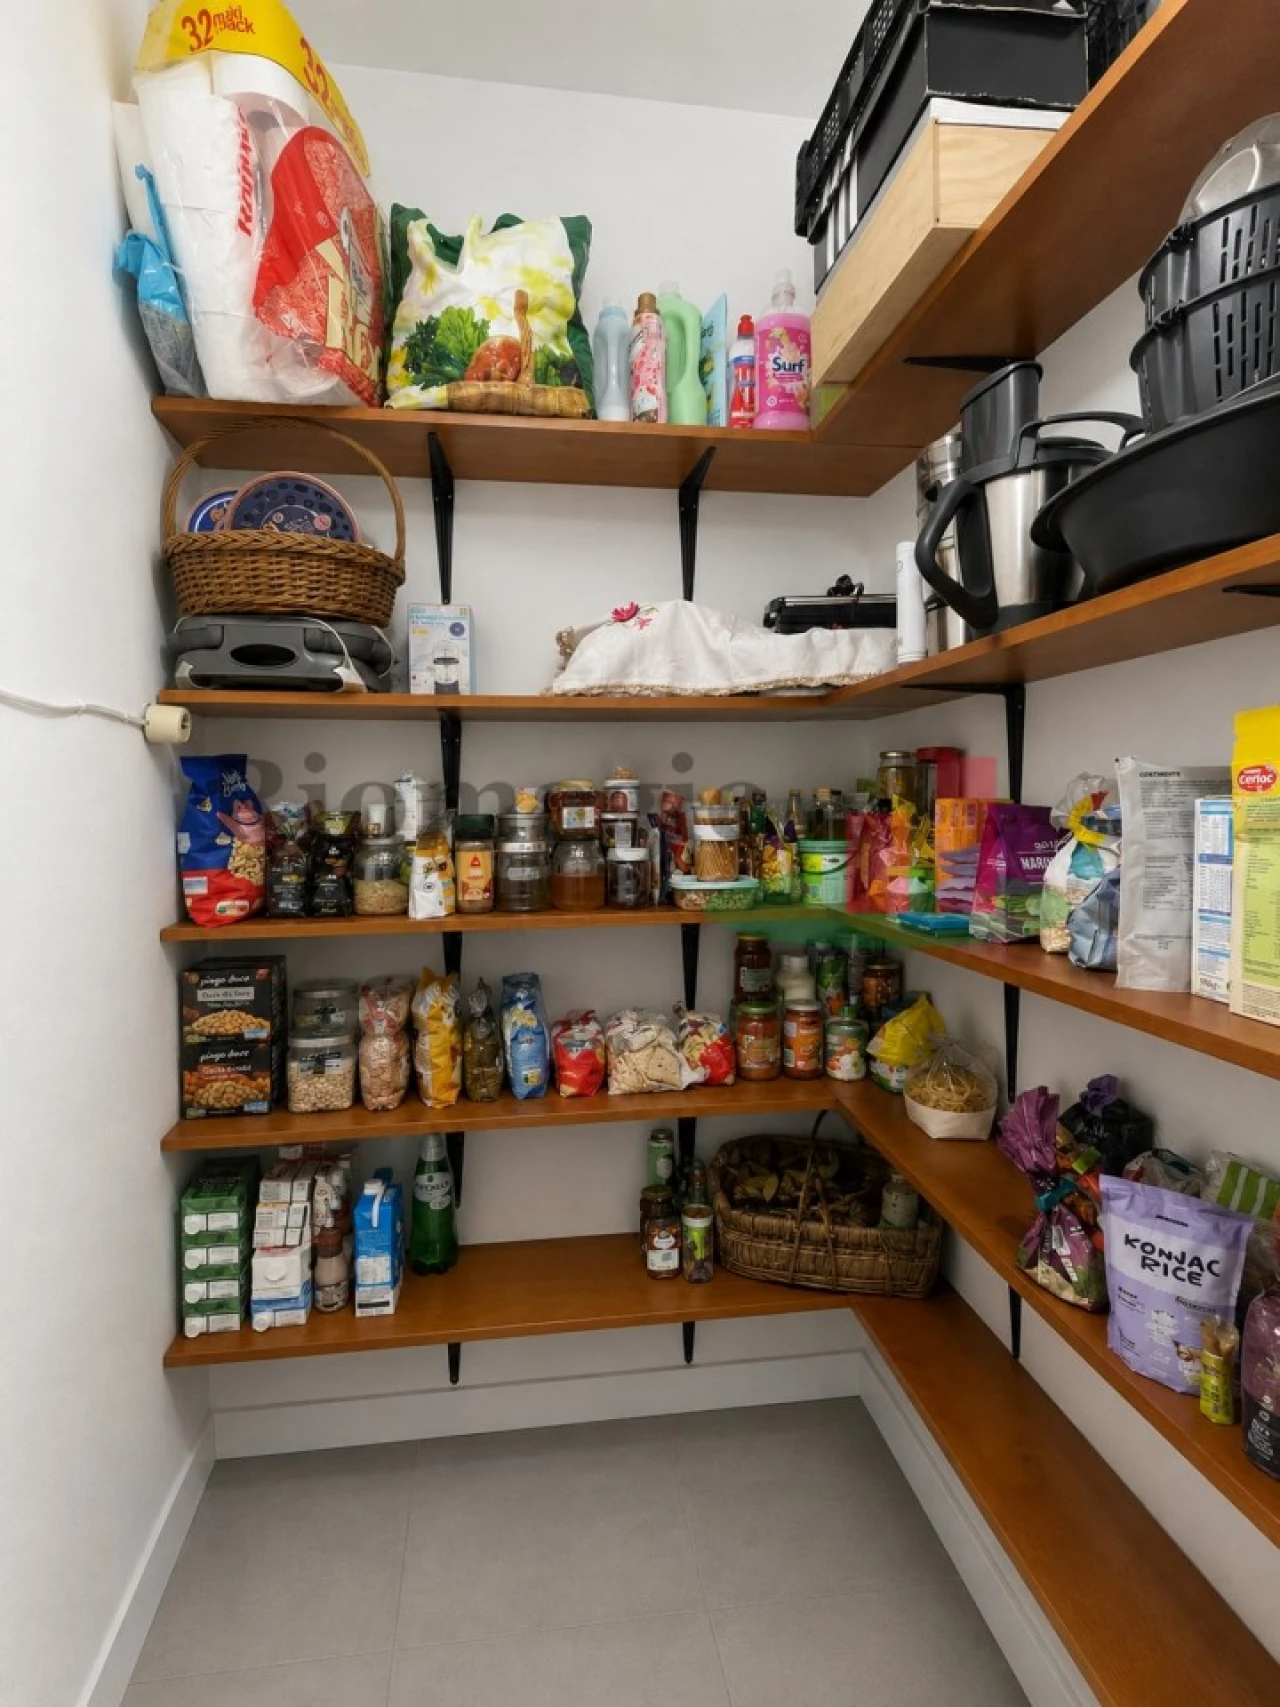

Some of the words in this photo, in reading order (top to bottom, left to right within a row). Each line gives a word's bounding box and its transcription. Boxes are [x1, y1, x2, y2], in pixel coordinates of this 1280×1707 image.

[182, 9, 213, 53] 32
[773, 356, 804, 372] Surf
[1124, 1233, 1221, 1278] KONJAC
[1141, 1255, 1203, 1288] RICE
